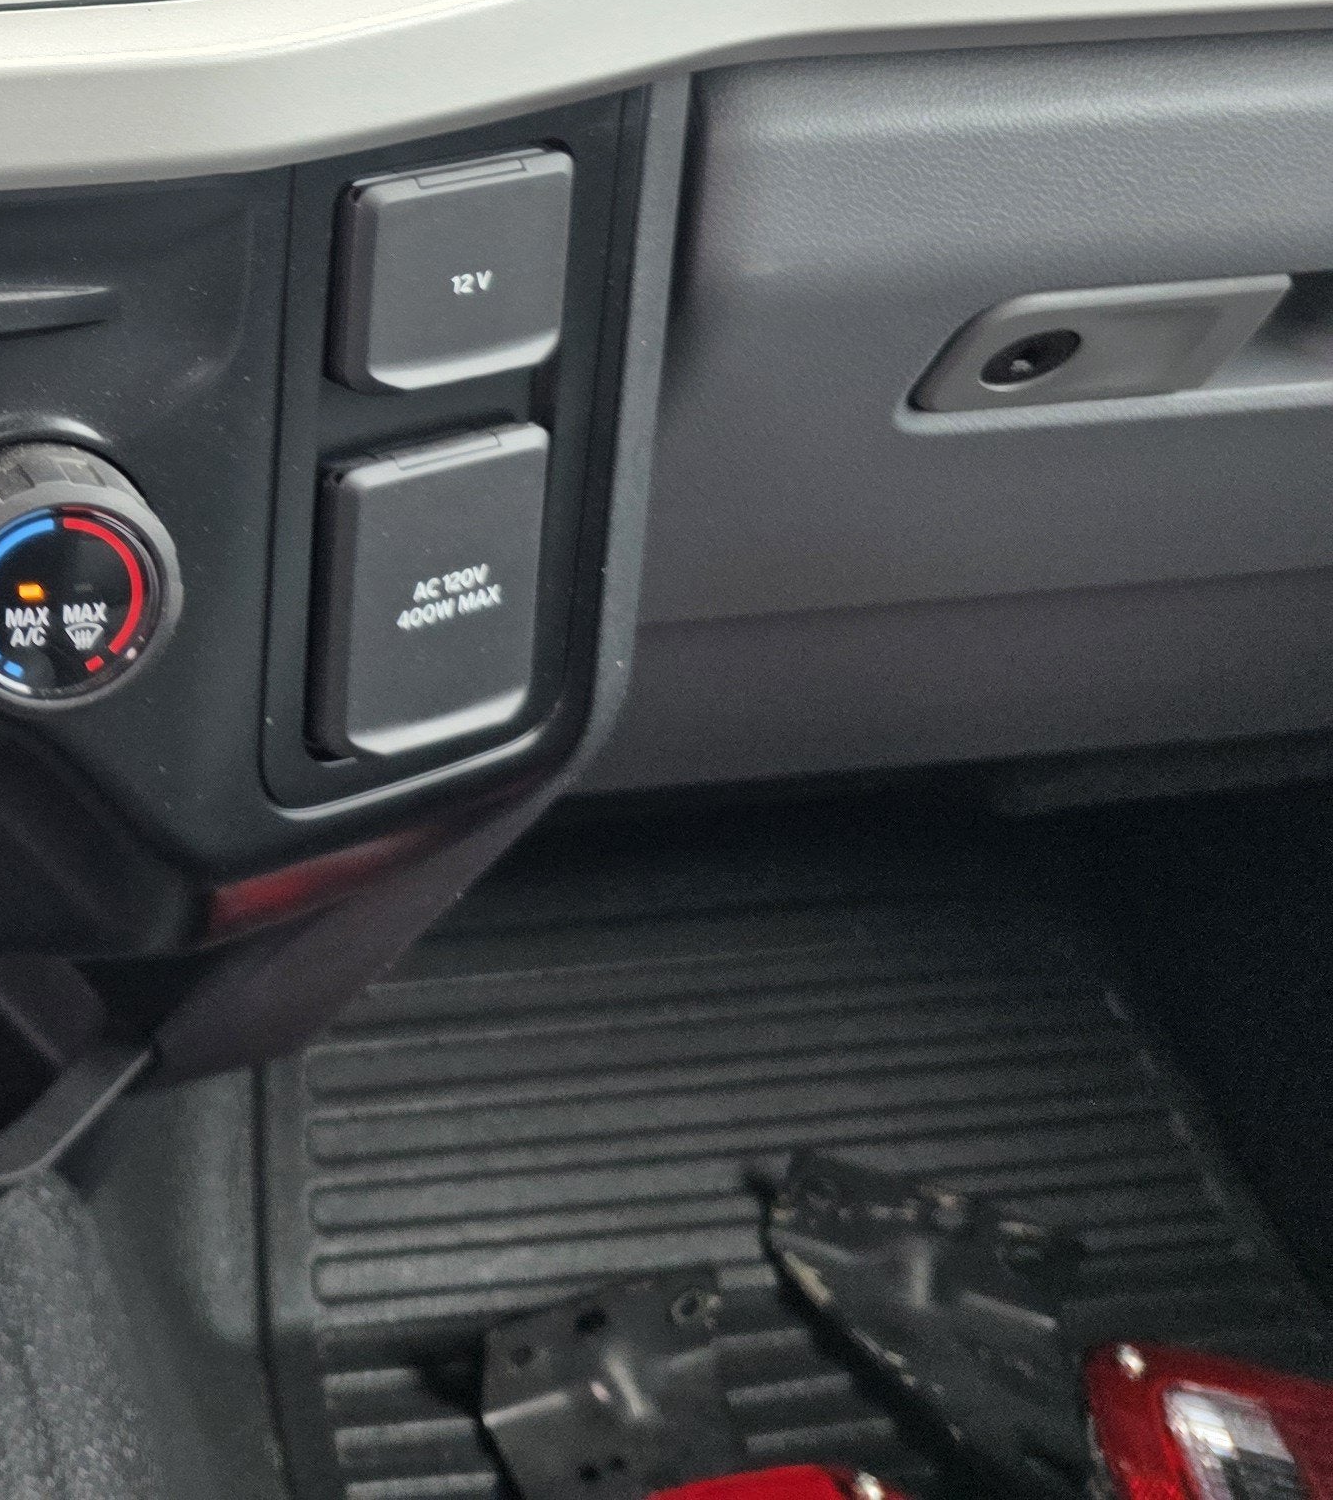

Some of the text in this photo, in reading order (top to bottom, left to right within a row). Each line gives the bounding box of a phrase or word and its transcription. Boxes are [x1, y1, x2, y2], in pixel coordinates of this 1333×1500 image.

[450, 268, 493, 296] 12 V
[413, 563, 491, 603] AC 120V
[5, 605, 51, 629] MAX
[62, 601, 109, 625] MAX
[395, 583, 503, 631] 400W MAX
[9, 626, 48, 648] A/C
